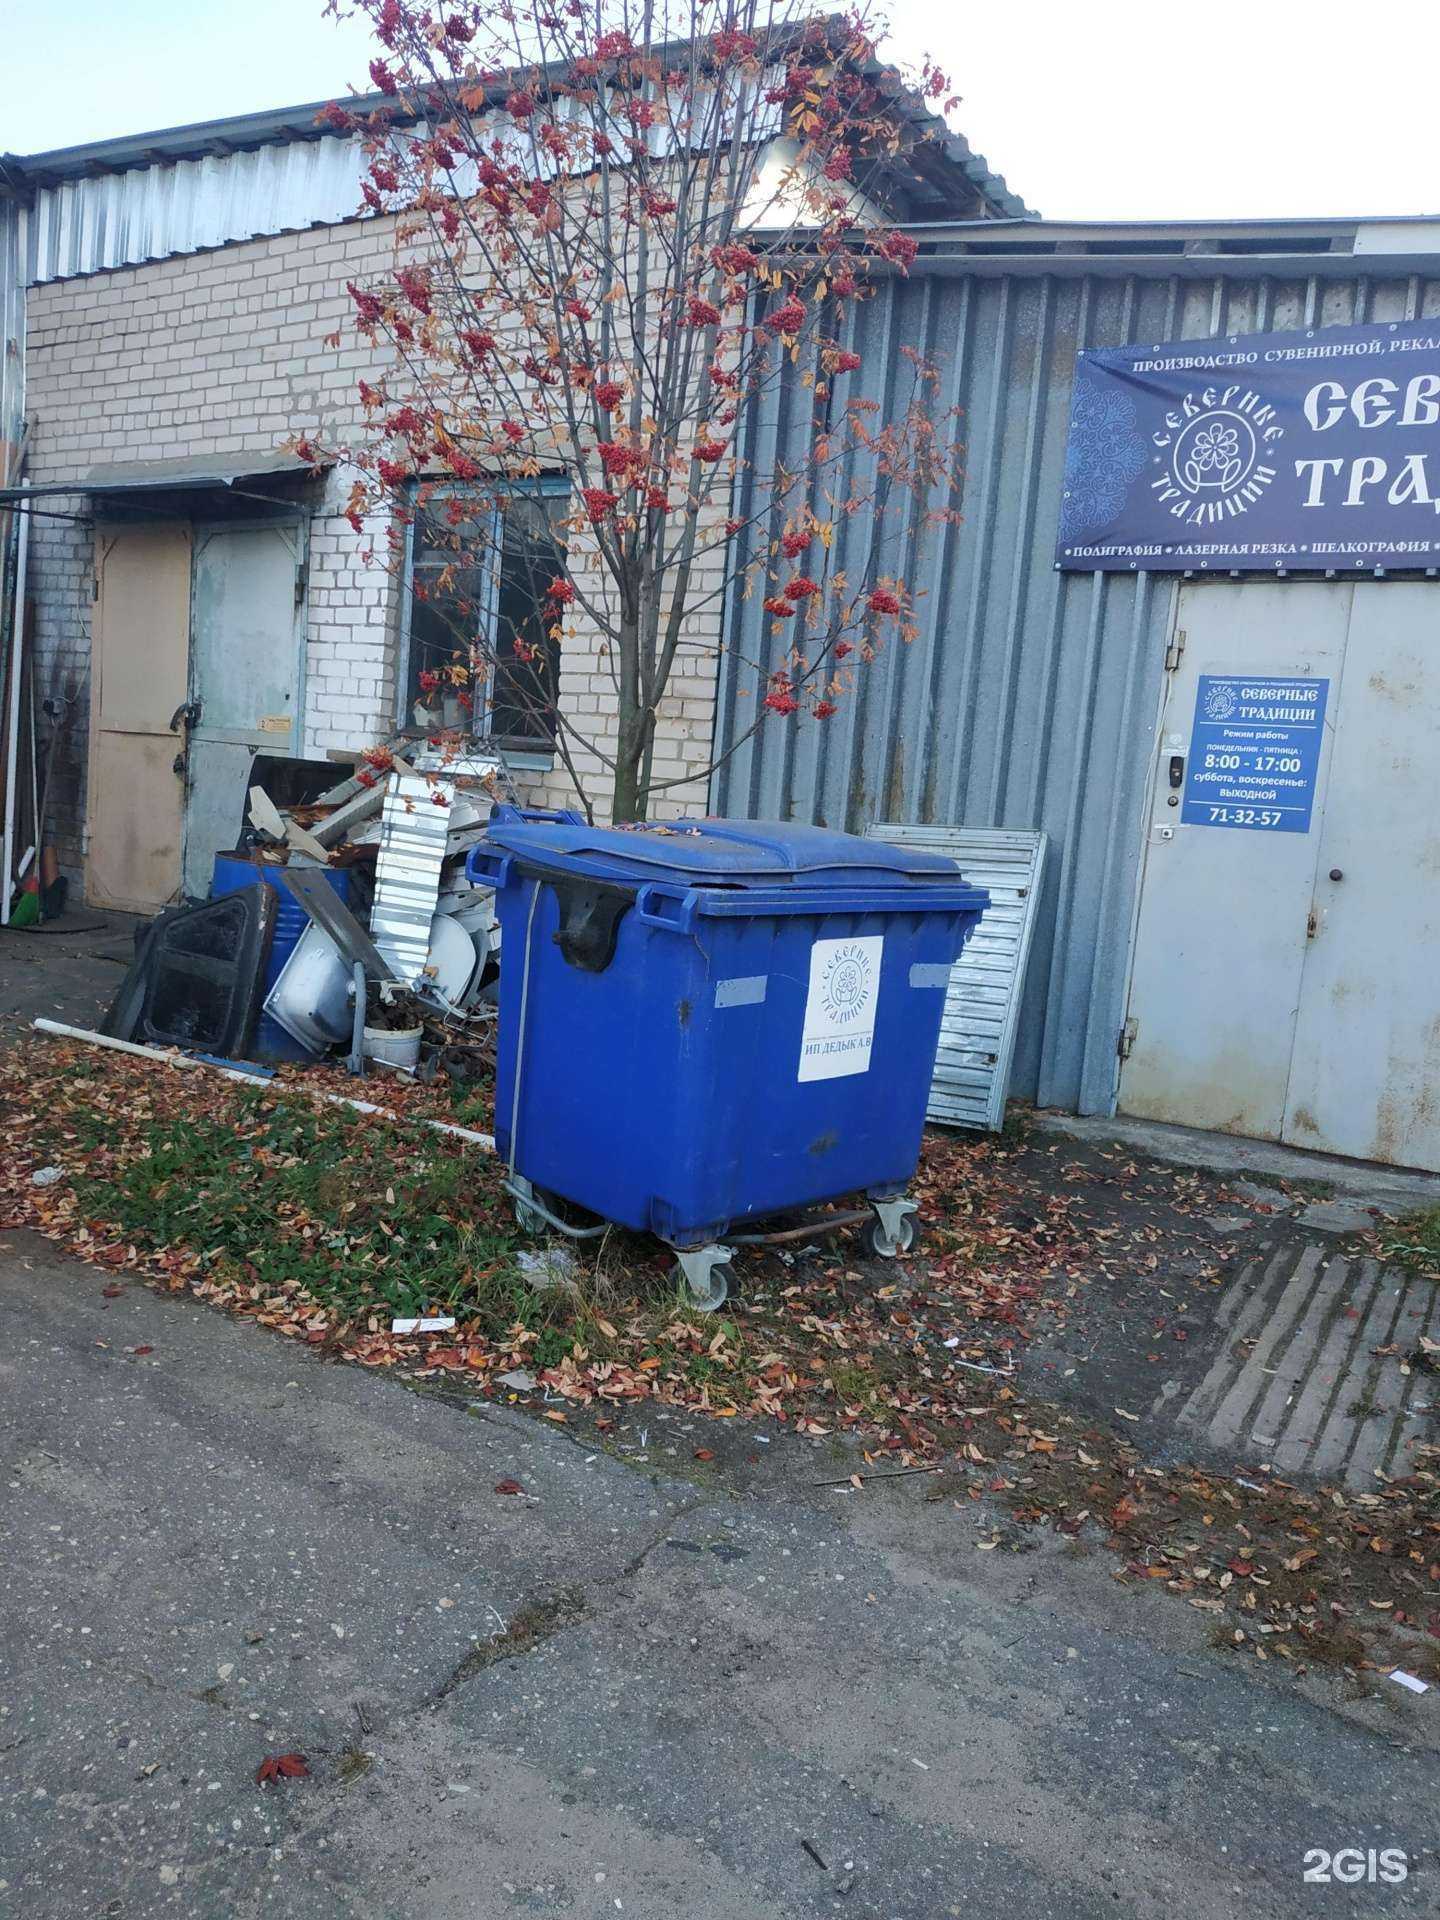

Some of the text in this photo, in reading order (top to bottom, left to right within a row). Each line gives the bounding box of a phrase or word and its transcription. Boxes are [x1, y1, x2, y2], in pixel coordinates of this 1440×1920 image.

[1132, 352, 1258, 372] ПРОИЗВОДСТВО
[1264, 338, 1385, 362] СУВЕНИРНОЙ,
[1152, 386, 1284, 447] СЕВЕРНЫЕ
[1295, 454, 1440, 515] ТРА
[1151, 465, 1277, 527] ТРАДИЦИИ
[1073, 541, 1430, 557] ПОЛИГРАФИЯ ЛАЗЕРНАЯ РЕЗКА ШЕЛКОГРАФИЯ
[1241, 688, 1318, 702] СЕВЕРНЫЕ
[1239, 706, 1316, 722] ТРАДИЦИИ
[1223, 729, 1289, 742] Режим работы
[1205, 754, 1240, 769] 8:00
[1254, 756, 1301, 772] 17:00
[1194, 772, 1308, 787] суббота, воскресенье:
[1209, 807, 1282, 826] 71-32-57
[805, 1043, 821, 1055] ИП
[821, 1039, 857, 1056] ДЕДЫК
